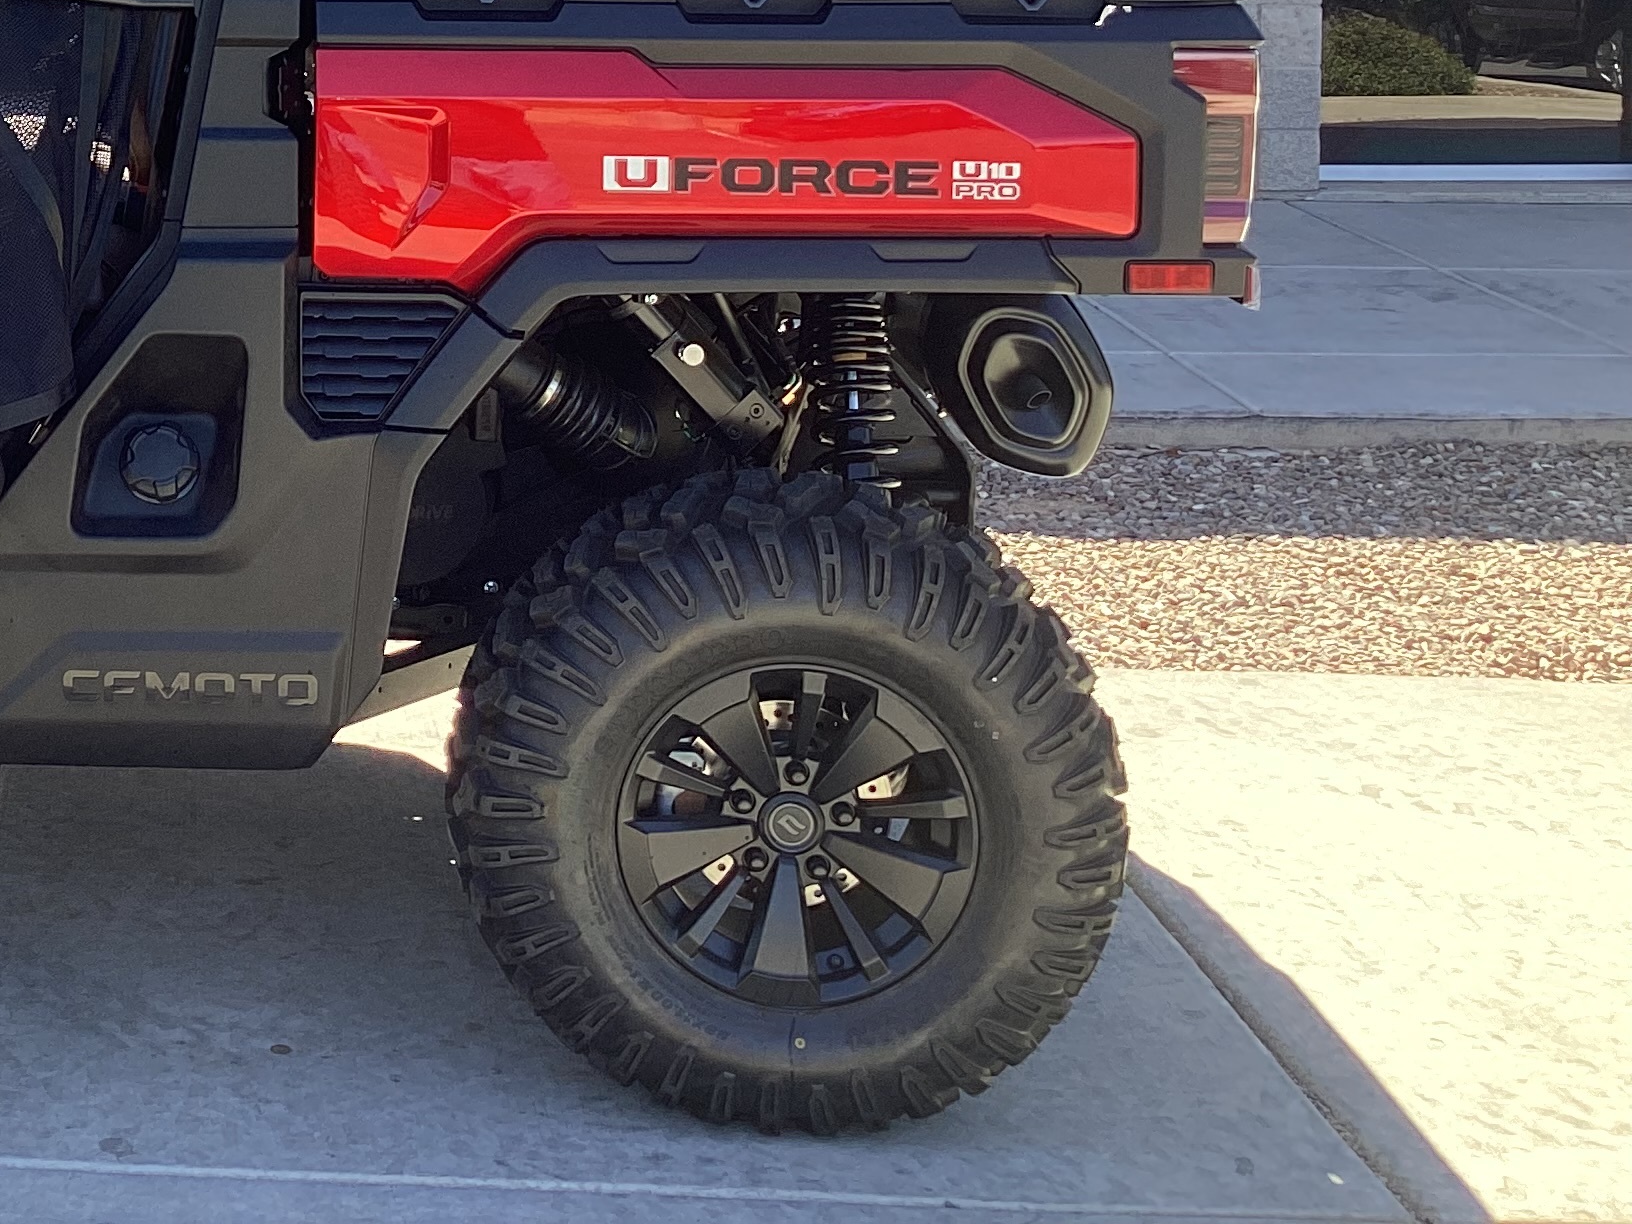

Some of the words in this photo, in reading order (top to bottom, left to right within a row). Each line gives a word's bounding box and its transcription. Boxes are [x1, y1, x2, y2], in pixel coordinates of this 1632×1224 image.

[952, 160, 1021, 180] U10
[952, 181, 1021, 201] PRO
[62, 668, 319, 706] CFMOTO
